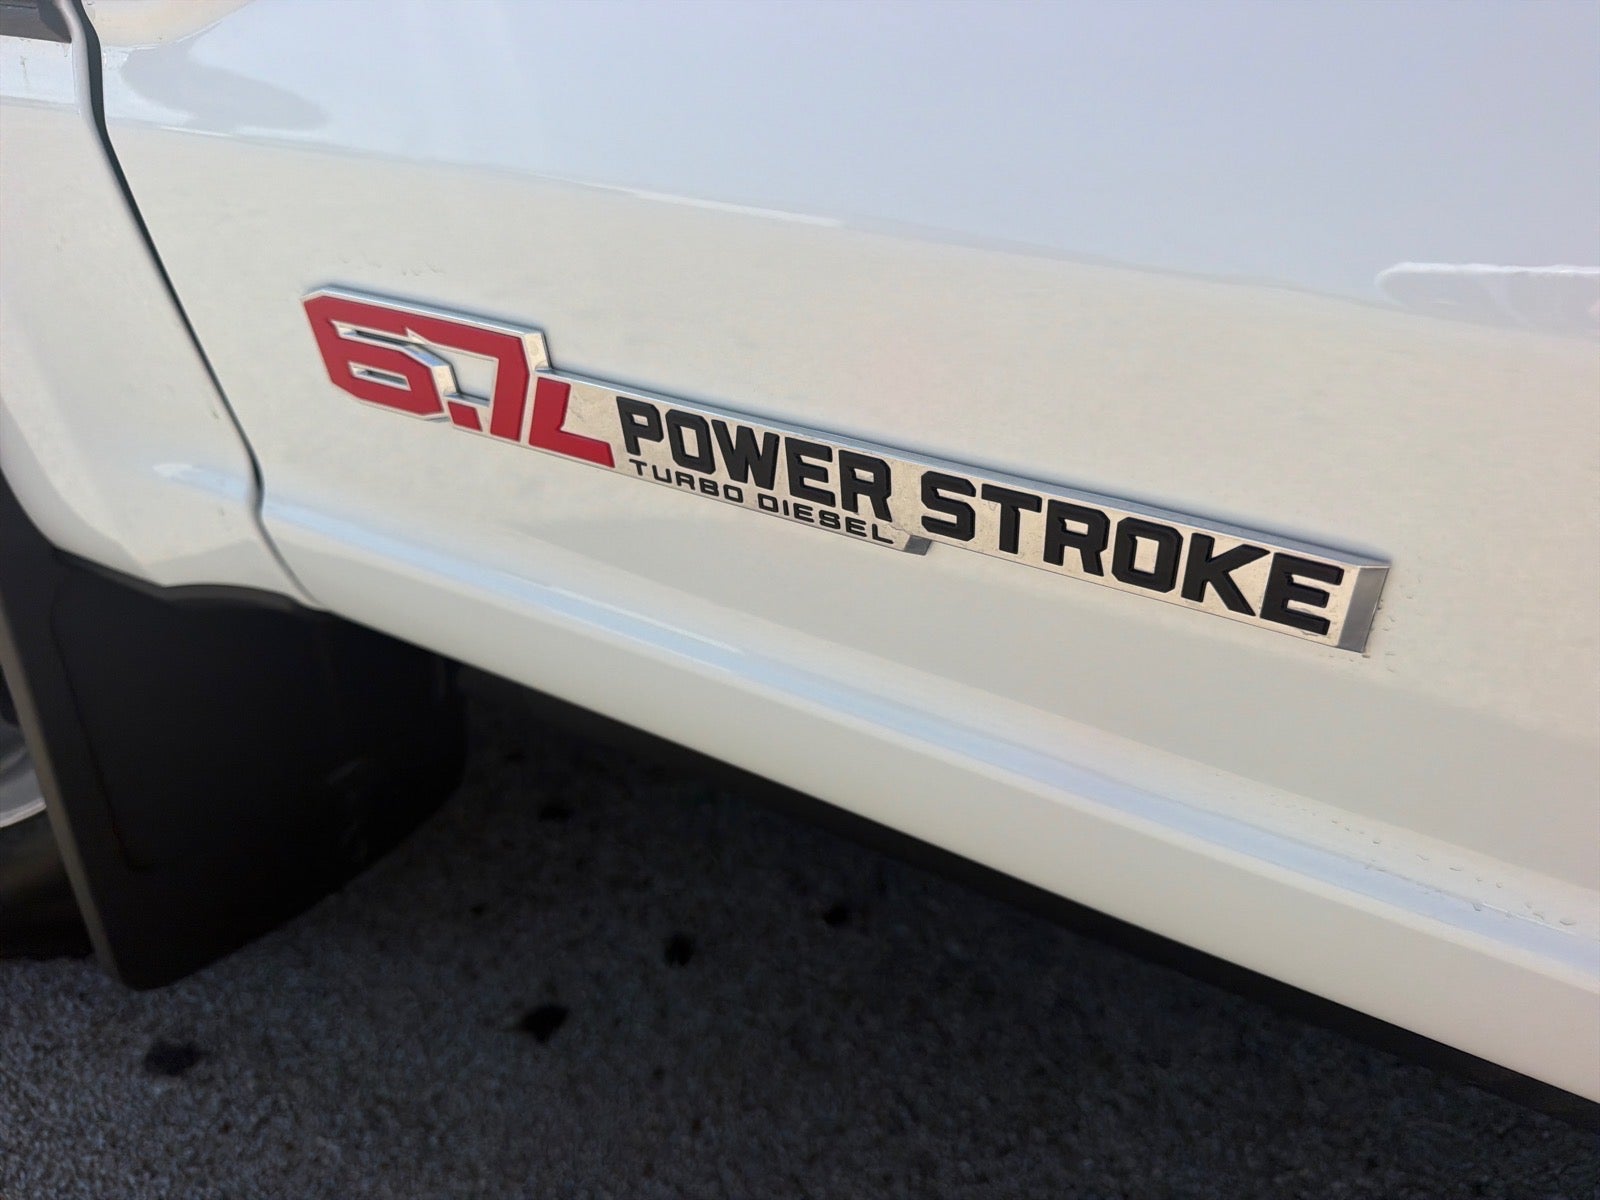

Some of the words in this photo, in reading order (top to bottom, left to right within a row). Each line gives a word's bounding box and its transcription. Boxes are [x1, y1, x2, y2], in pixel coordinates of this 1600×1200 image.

[303, 294, 615, 469] 6.7L
[616, 396, 893, 523] POWER
[921, 470, 1345, 636] STROKE
[629, 458, 744, 504] TURBO
[757, 493, 894, 545] DIESEL
